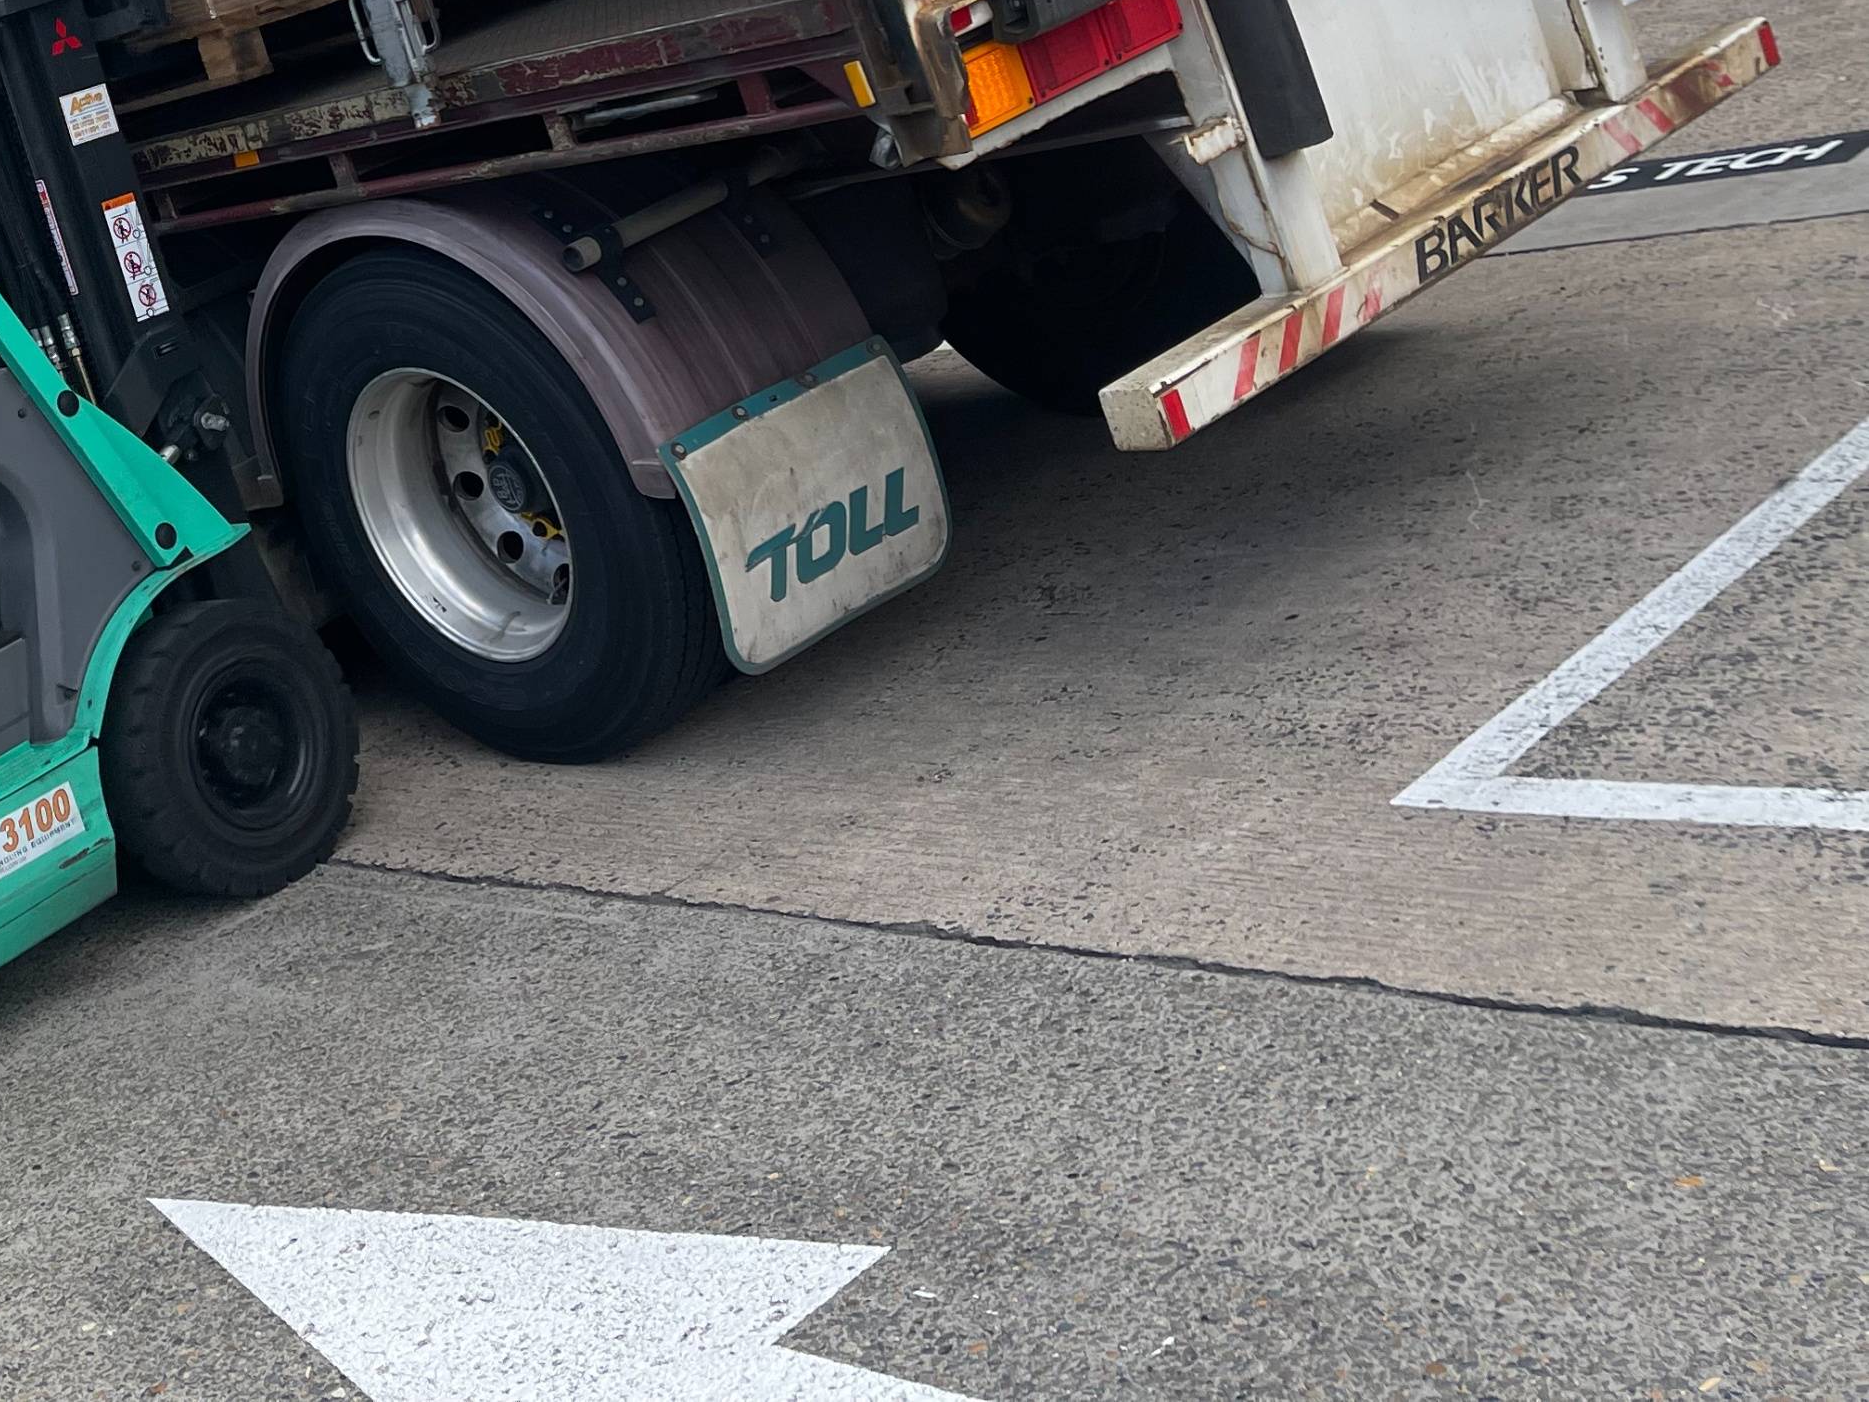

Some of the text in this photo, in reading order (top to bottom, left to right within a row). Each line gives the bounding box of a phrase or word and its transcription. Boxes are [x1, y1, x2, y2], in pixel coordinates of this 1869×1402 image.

[1653, 139, 1845, 181] TECH
[1414, 145, 1583, 285] BARKER
[745, 466, 920, 602] TOLL
[30, 817, 77, 848] EQUIPMENT
